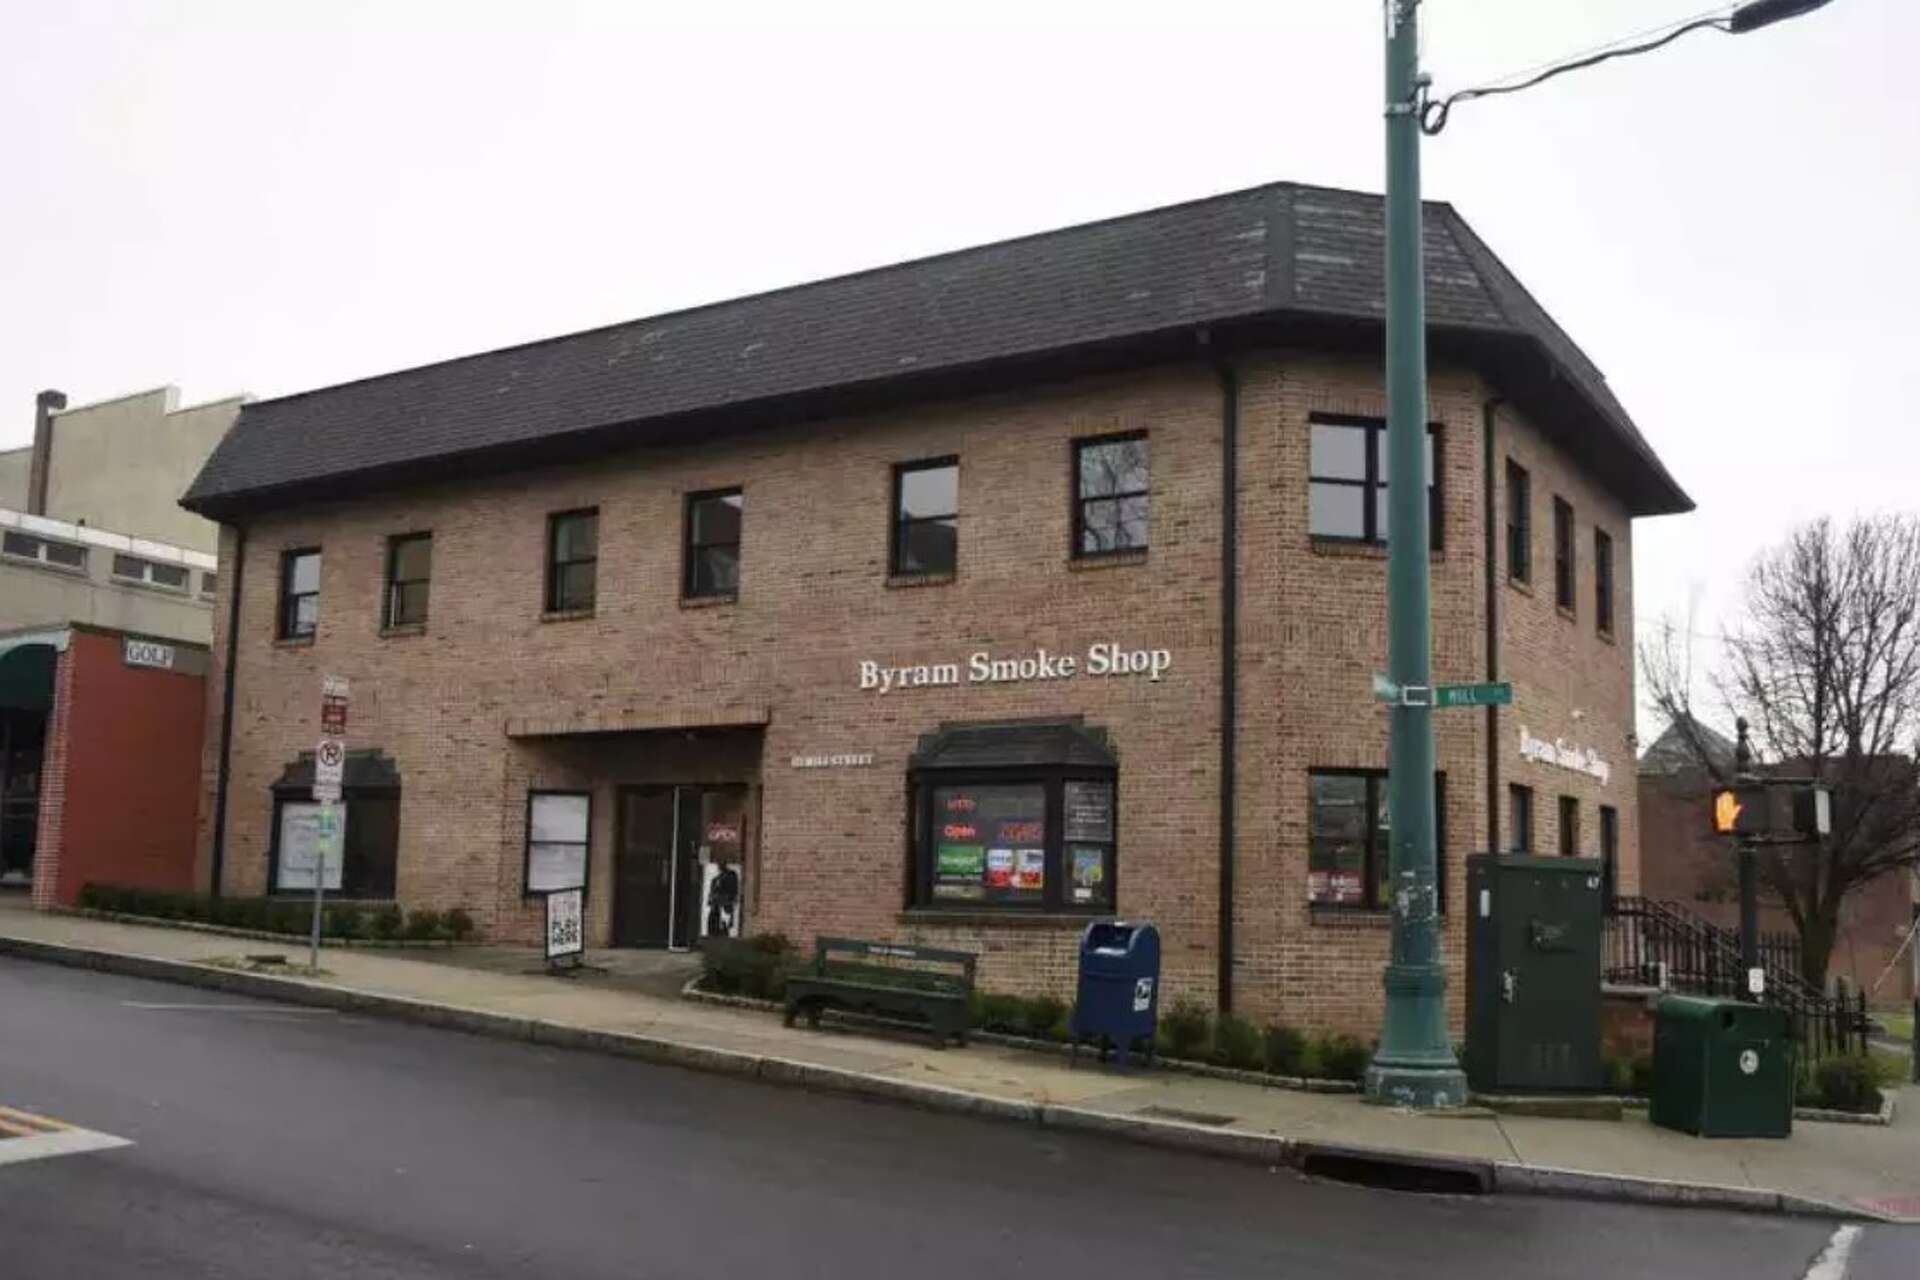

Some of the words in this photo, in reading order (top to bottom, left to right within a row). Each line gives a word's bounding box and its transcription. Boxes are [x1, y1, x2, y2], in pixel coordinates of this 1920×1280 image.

[128, 646, 171, 666] GOLF
[860, 660, 959, 694] Byram
[969, 652, 1076, 682] Smoke
[1087, 643, 1171, 681] Shop
